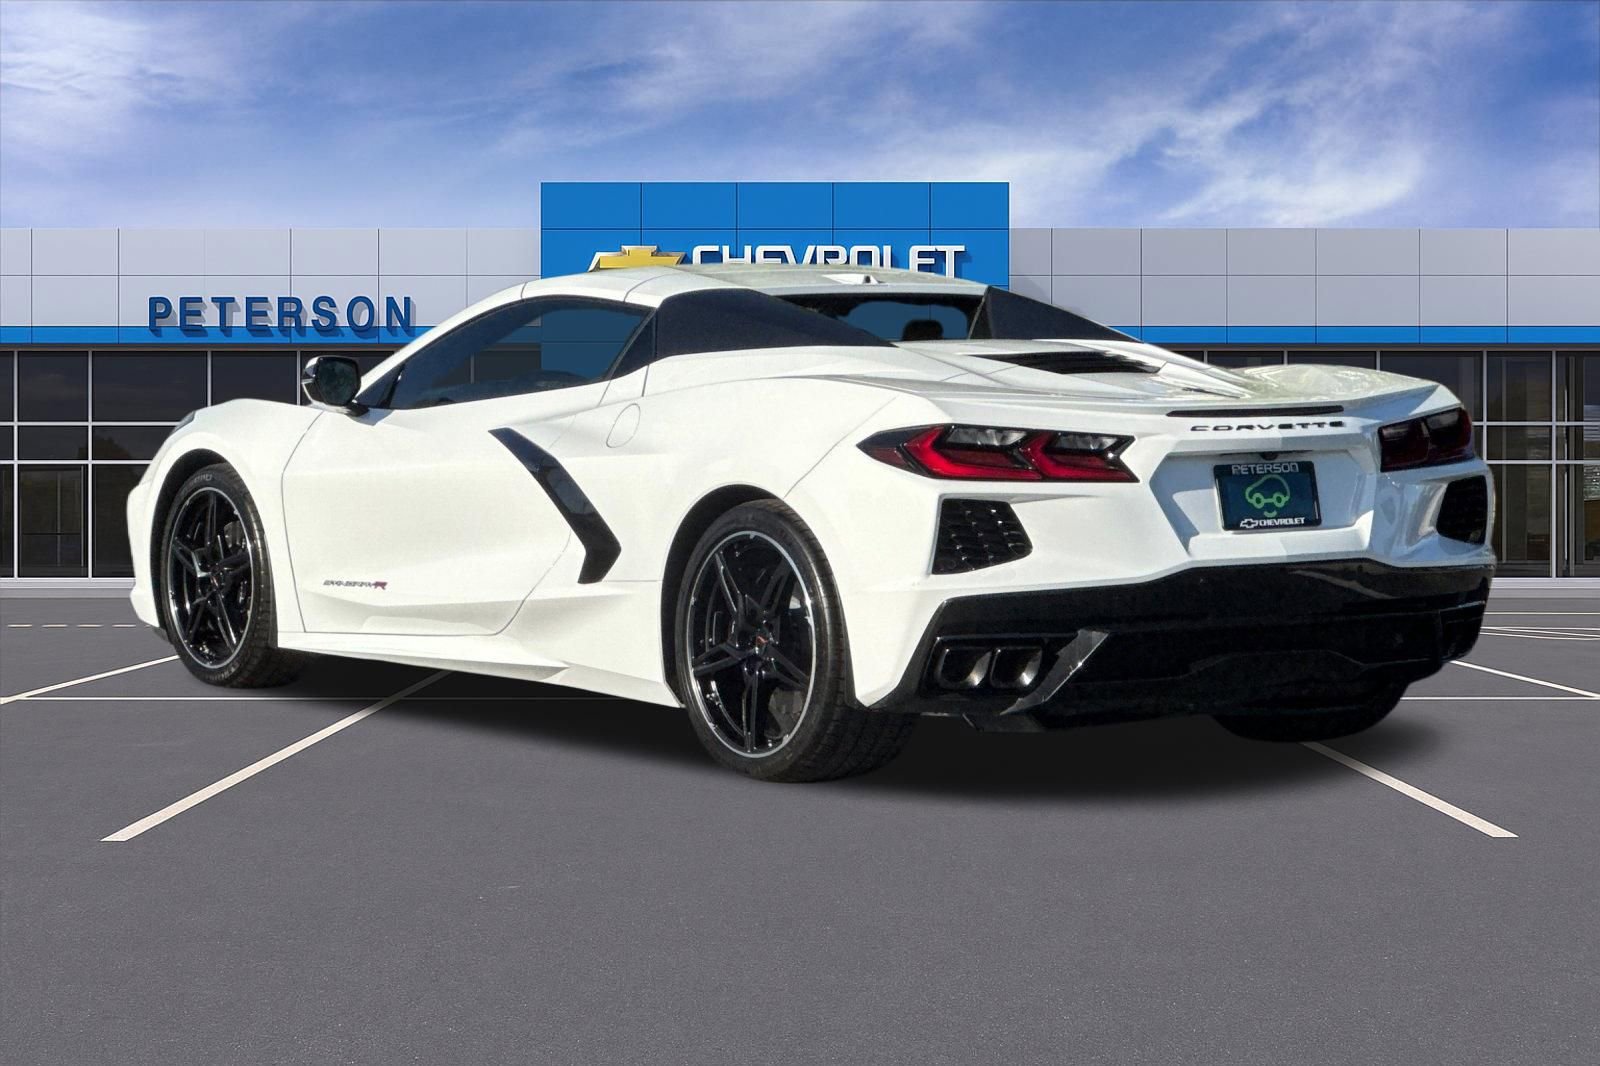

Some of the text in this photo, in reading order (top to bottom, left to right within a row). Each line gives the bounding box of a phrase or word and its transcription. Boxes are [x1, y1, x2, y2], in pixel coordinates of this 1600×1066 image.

[149, 296, 411, 332] PETERSON
[1190, 421, 1345, 431] CORVETTE
[1231, 462, 1299, 475] PETERSON
[1259, 517, 1305, 526] CHEVROLET
